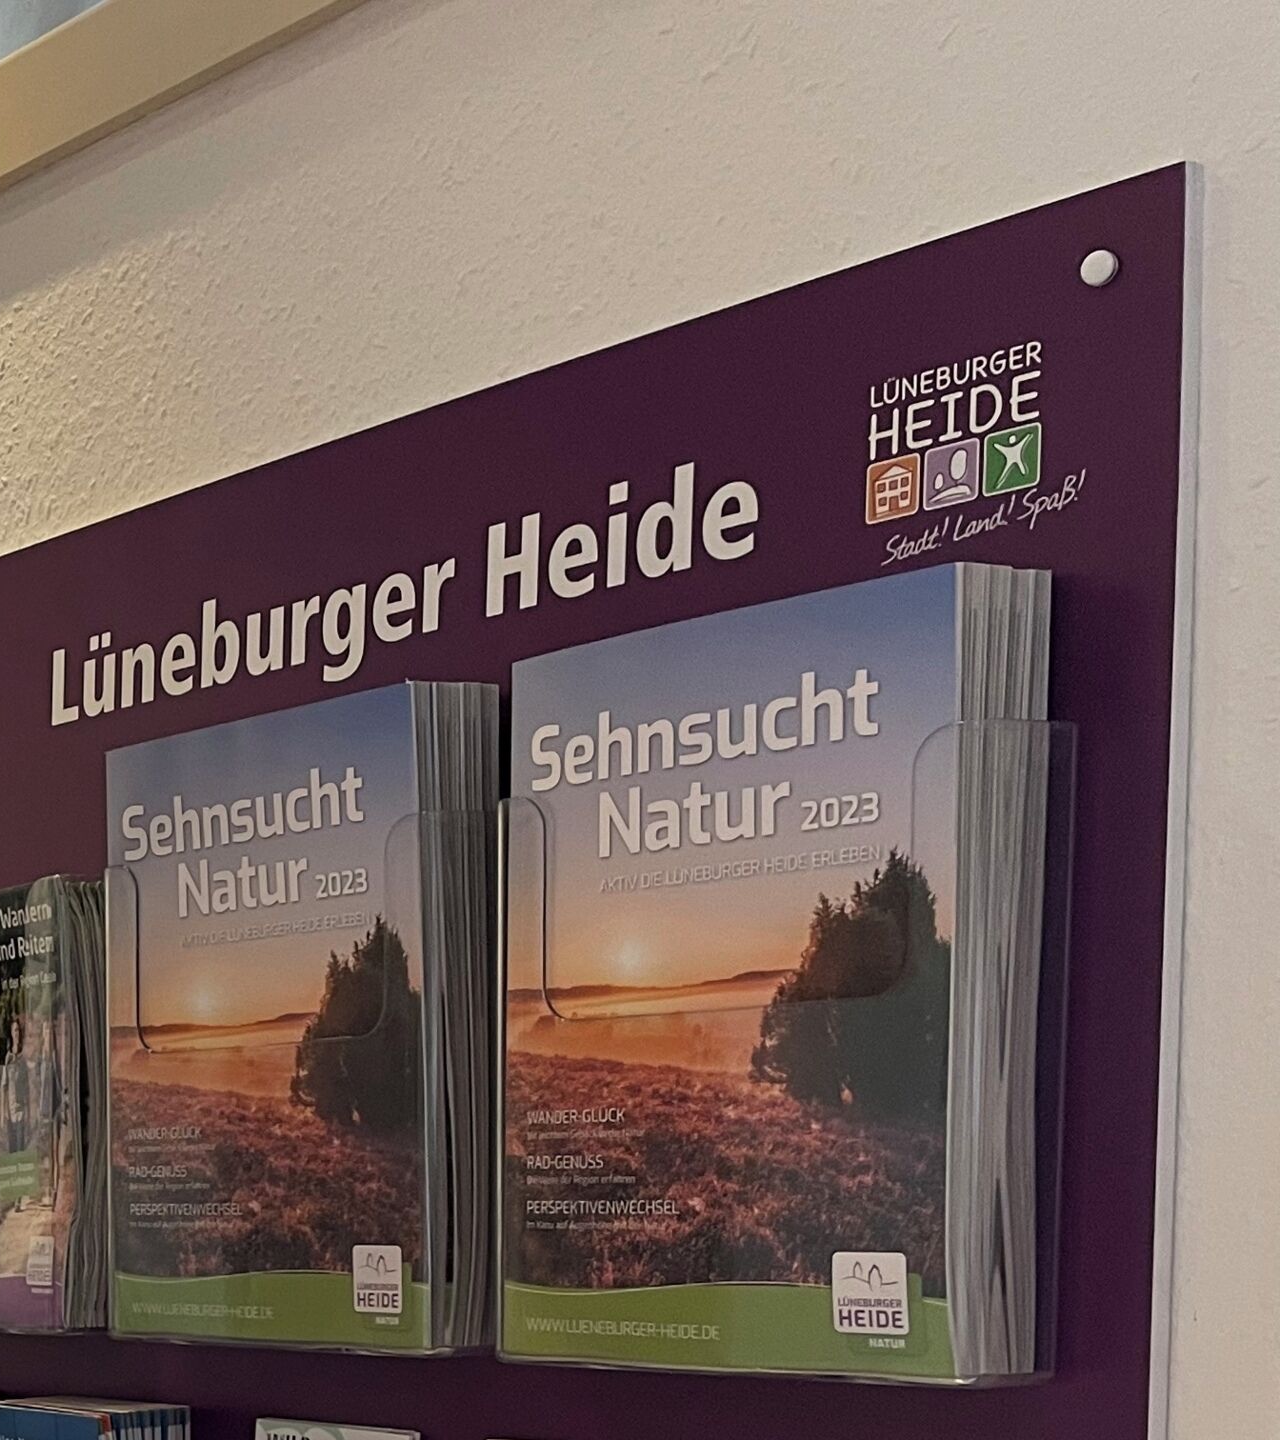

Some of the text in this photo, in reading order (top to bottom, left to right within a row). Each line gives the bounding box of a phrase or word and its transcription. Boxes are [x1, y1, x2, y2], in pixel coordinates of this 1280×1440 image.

[870, 341, 1042, 408] LÜNEBURGER
[868, 370, 1041, 461] HEIDE
[881, 468, 1087, 567] Stadt! Land! Spaß!
[49, 461, 758, 725] Lüneburger Heide
[530, 668, 880, 792] Sehnsucht
[121, 766, 364, 862] Sehnsucht
[598, 780, 880, 859] Natur 2023
[177, 856, 369, 918] Natur 2023
[599, 845, 881, 893] AKTIV DIE LÜNEBURGER HEIDE ERLEBEN
[526, 1154, 604, 1169] RAD-GENUSS
[526, 1200, 680, 1215] PERSPEKTIVENWECHSEL
[356, 1291, 399, 1309] HEIDE
[837, 1296, 902, 1309] LÜNEBURGER
[838, 1309, 904, 1329] HEIDE
[526, 1317, 720, 1341] WWW.LUENEBURGER-HEIDE.DE
[868, 1337, 906, 1349] NATUR
